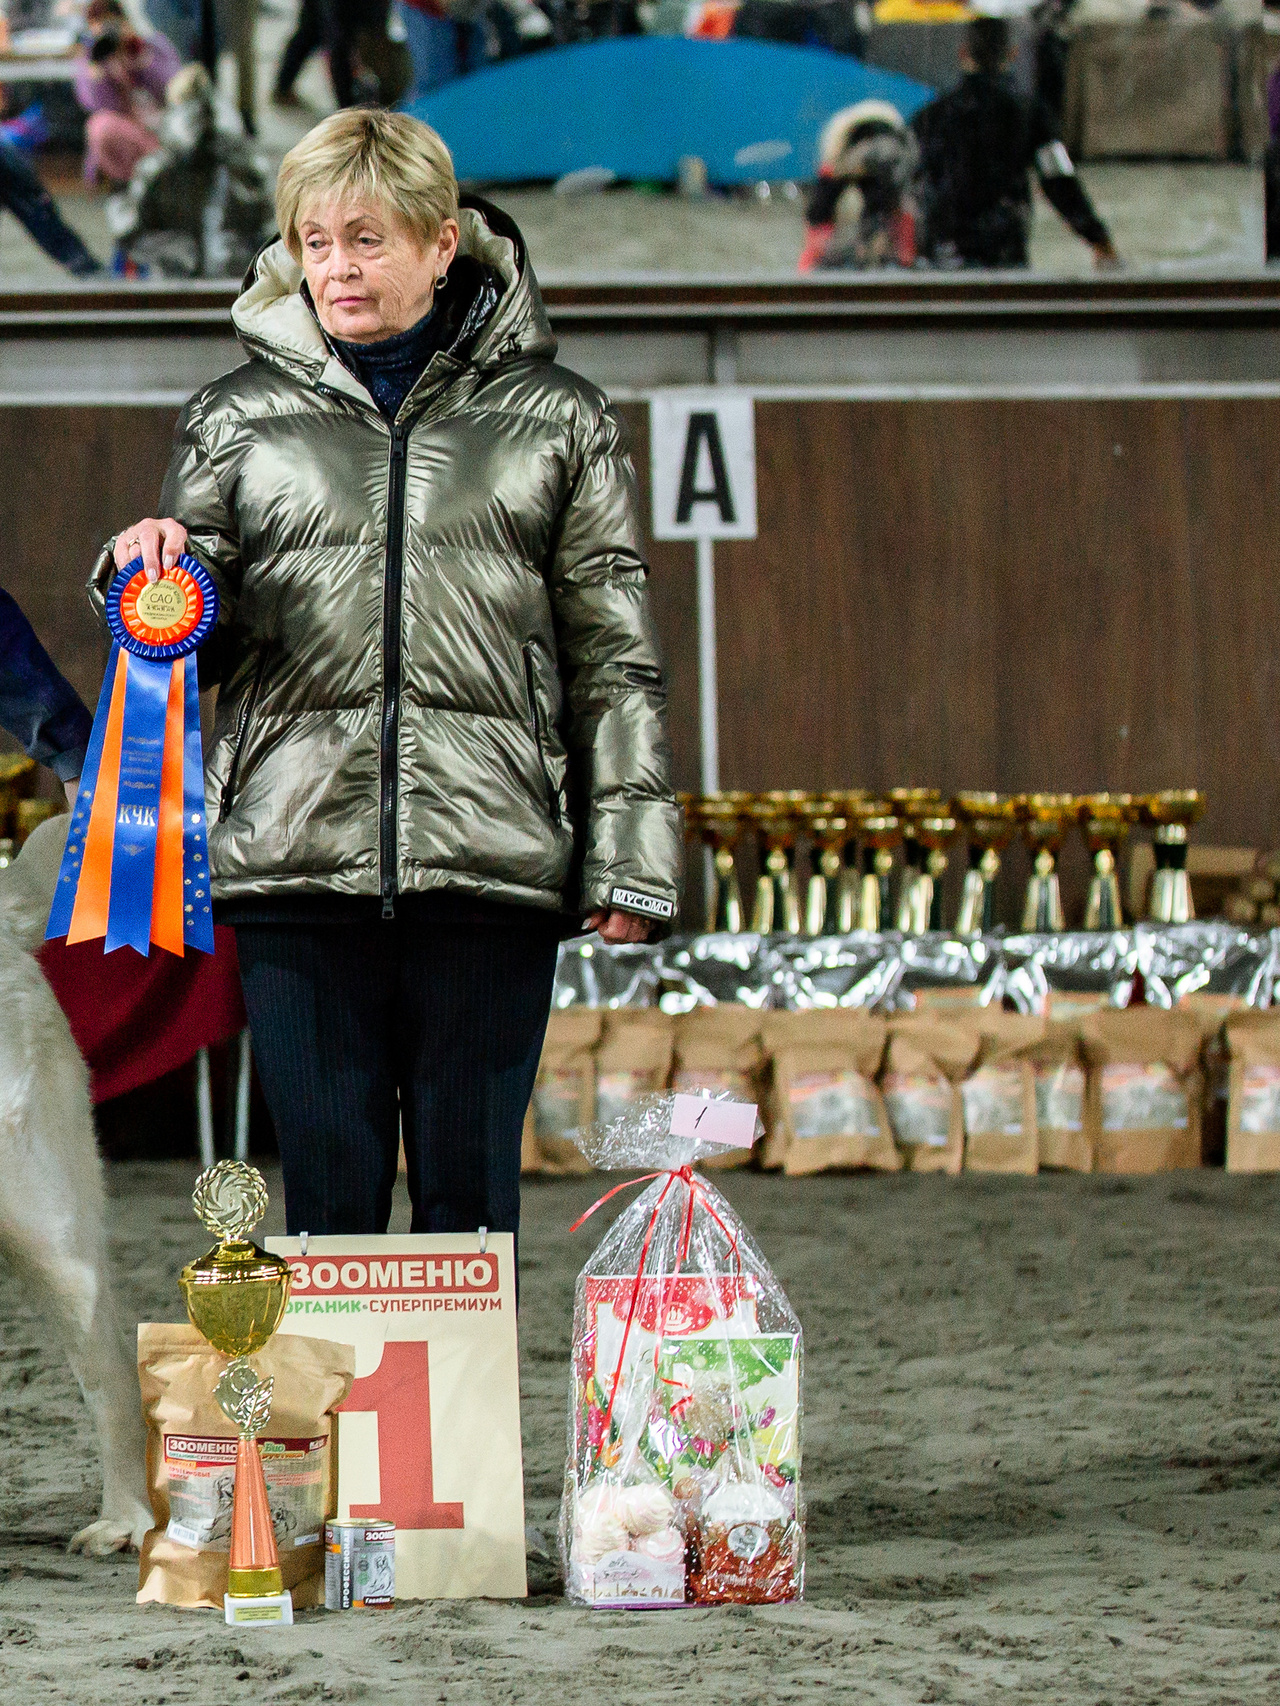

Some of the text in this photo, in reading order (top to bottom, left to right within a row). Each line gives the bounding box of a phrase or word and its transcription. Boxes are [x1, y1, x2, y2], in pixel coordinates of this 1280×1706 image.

[675, 413, 736, 523] A
[118, 803, 156, 827] КЧК
[694, 1106, 708, 1129] 1
[291, 1258, 493, 1290] ЗООМЕНЮ
[170, 1439, 238, 1454] ЗООМЕНЮ
[336, 1340, 464, 1530] 1
